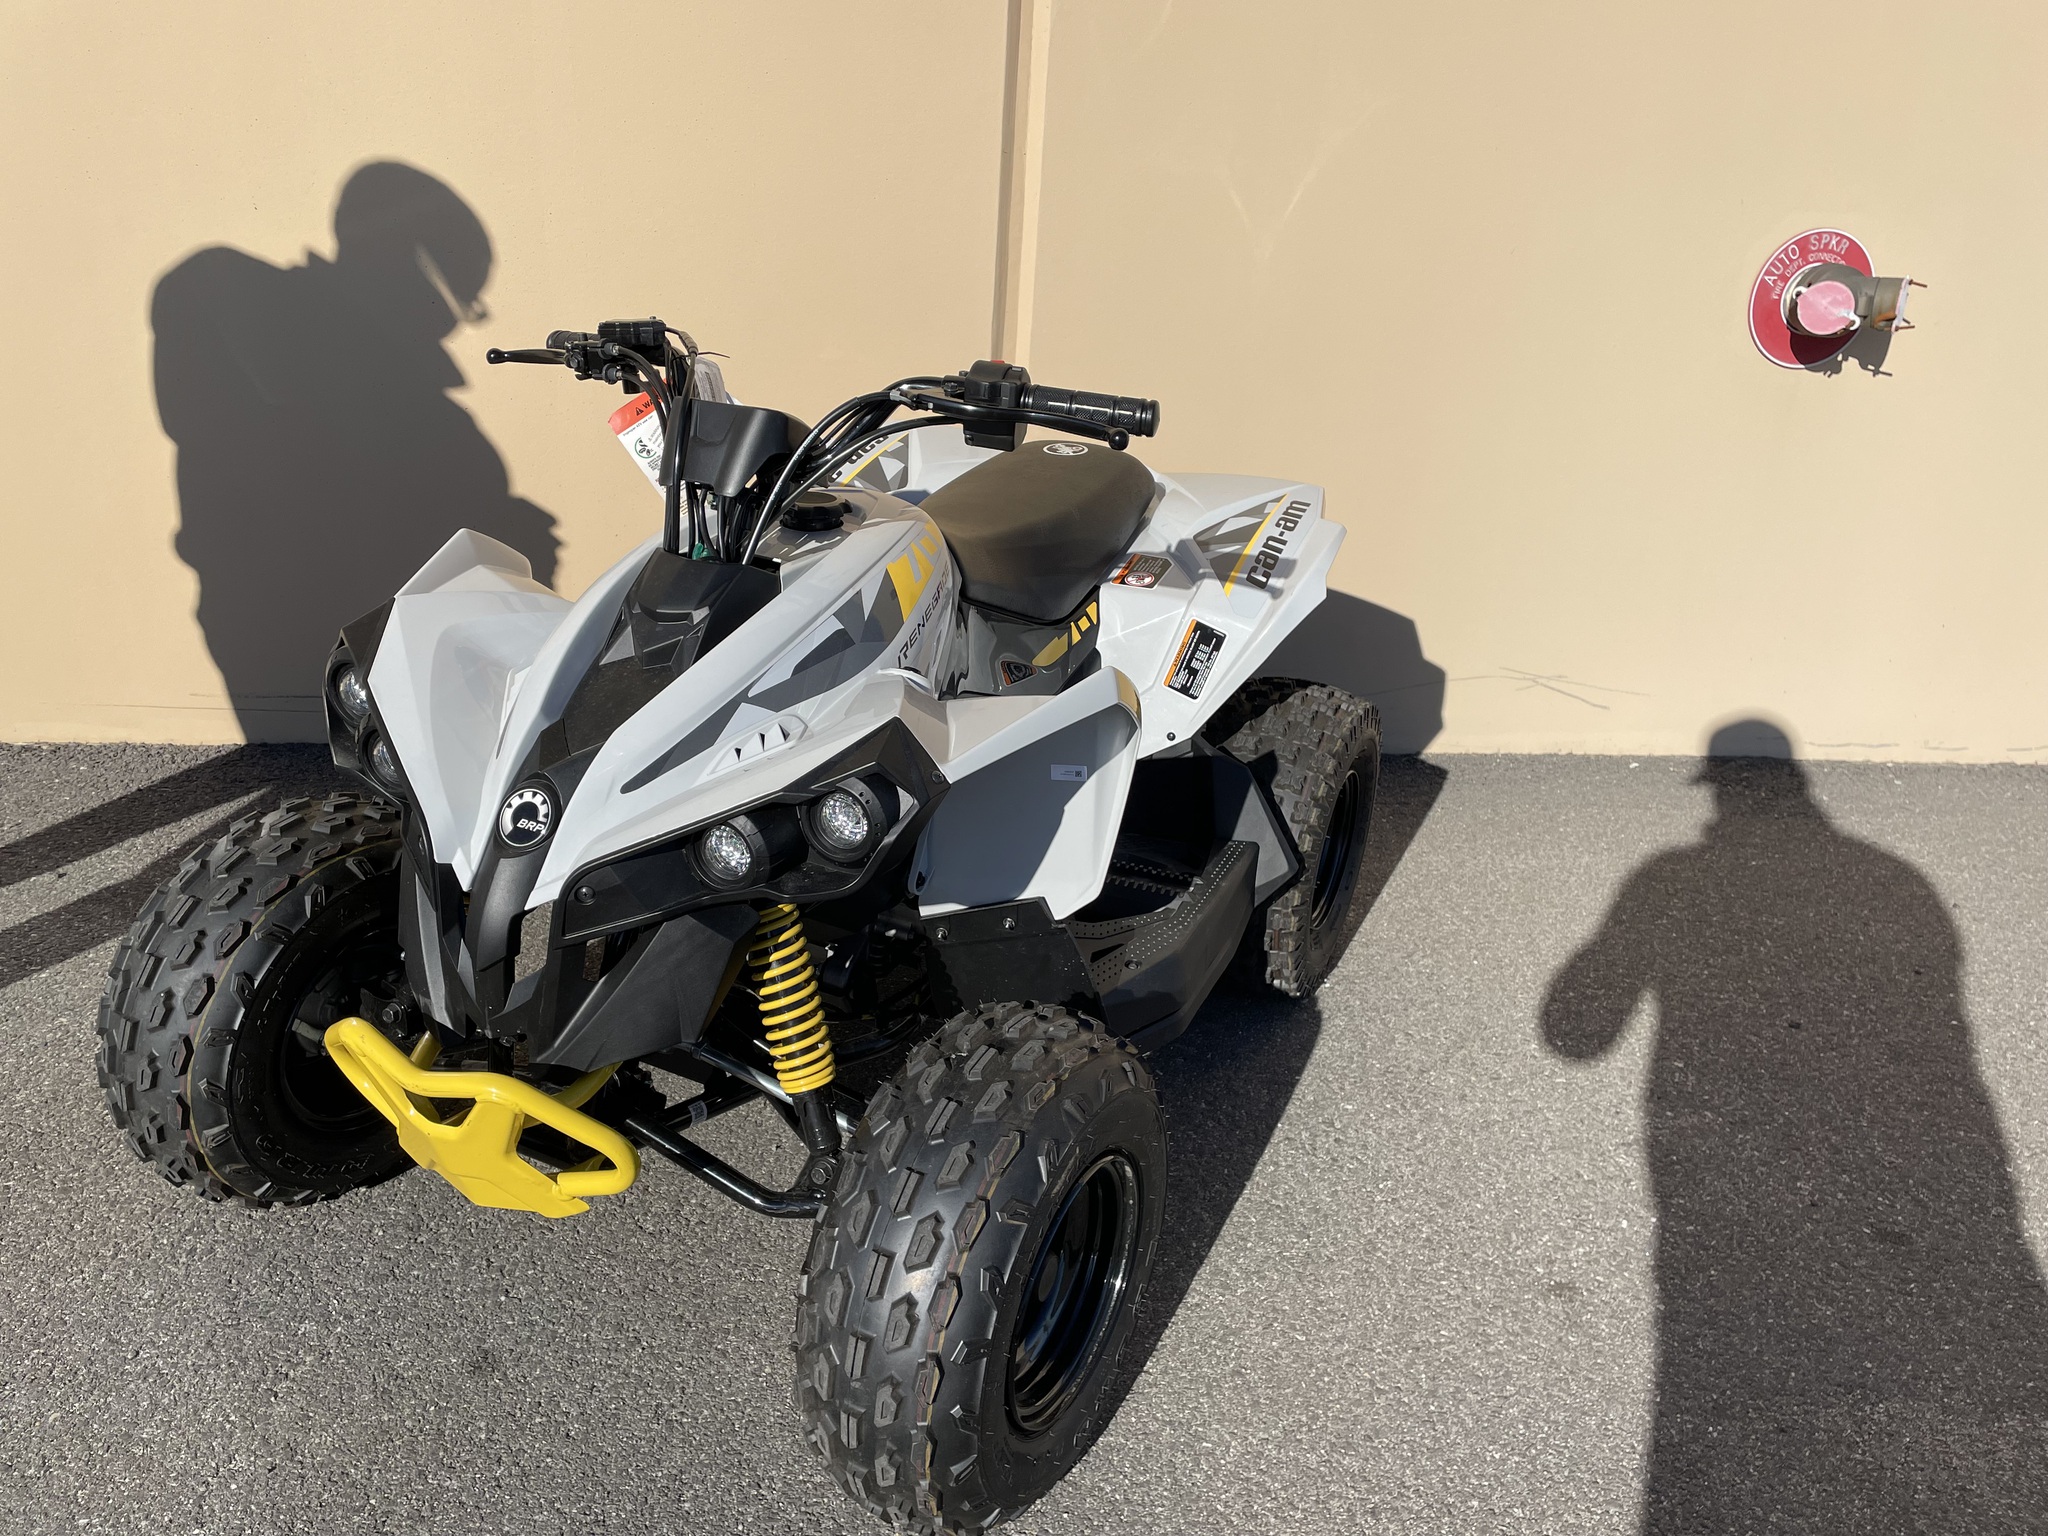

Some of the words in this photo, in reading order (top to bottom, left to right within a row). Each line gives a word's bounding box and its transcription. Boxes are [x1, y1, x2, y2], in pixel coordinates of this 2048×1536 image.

[1764, 244, 1800, 287] AUTO
[1809, 233, 1850, 255] SPKR
[1771, 280, 1786, 300] FIRE
[1245, 500, 1312, 590] can-am
[897, 560, 951, 669] RENEGADE
[516, 818, 545, 832] BRP
